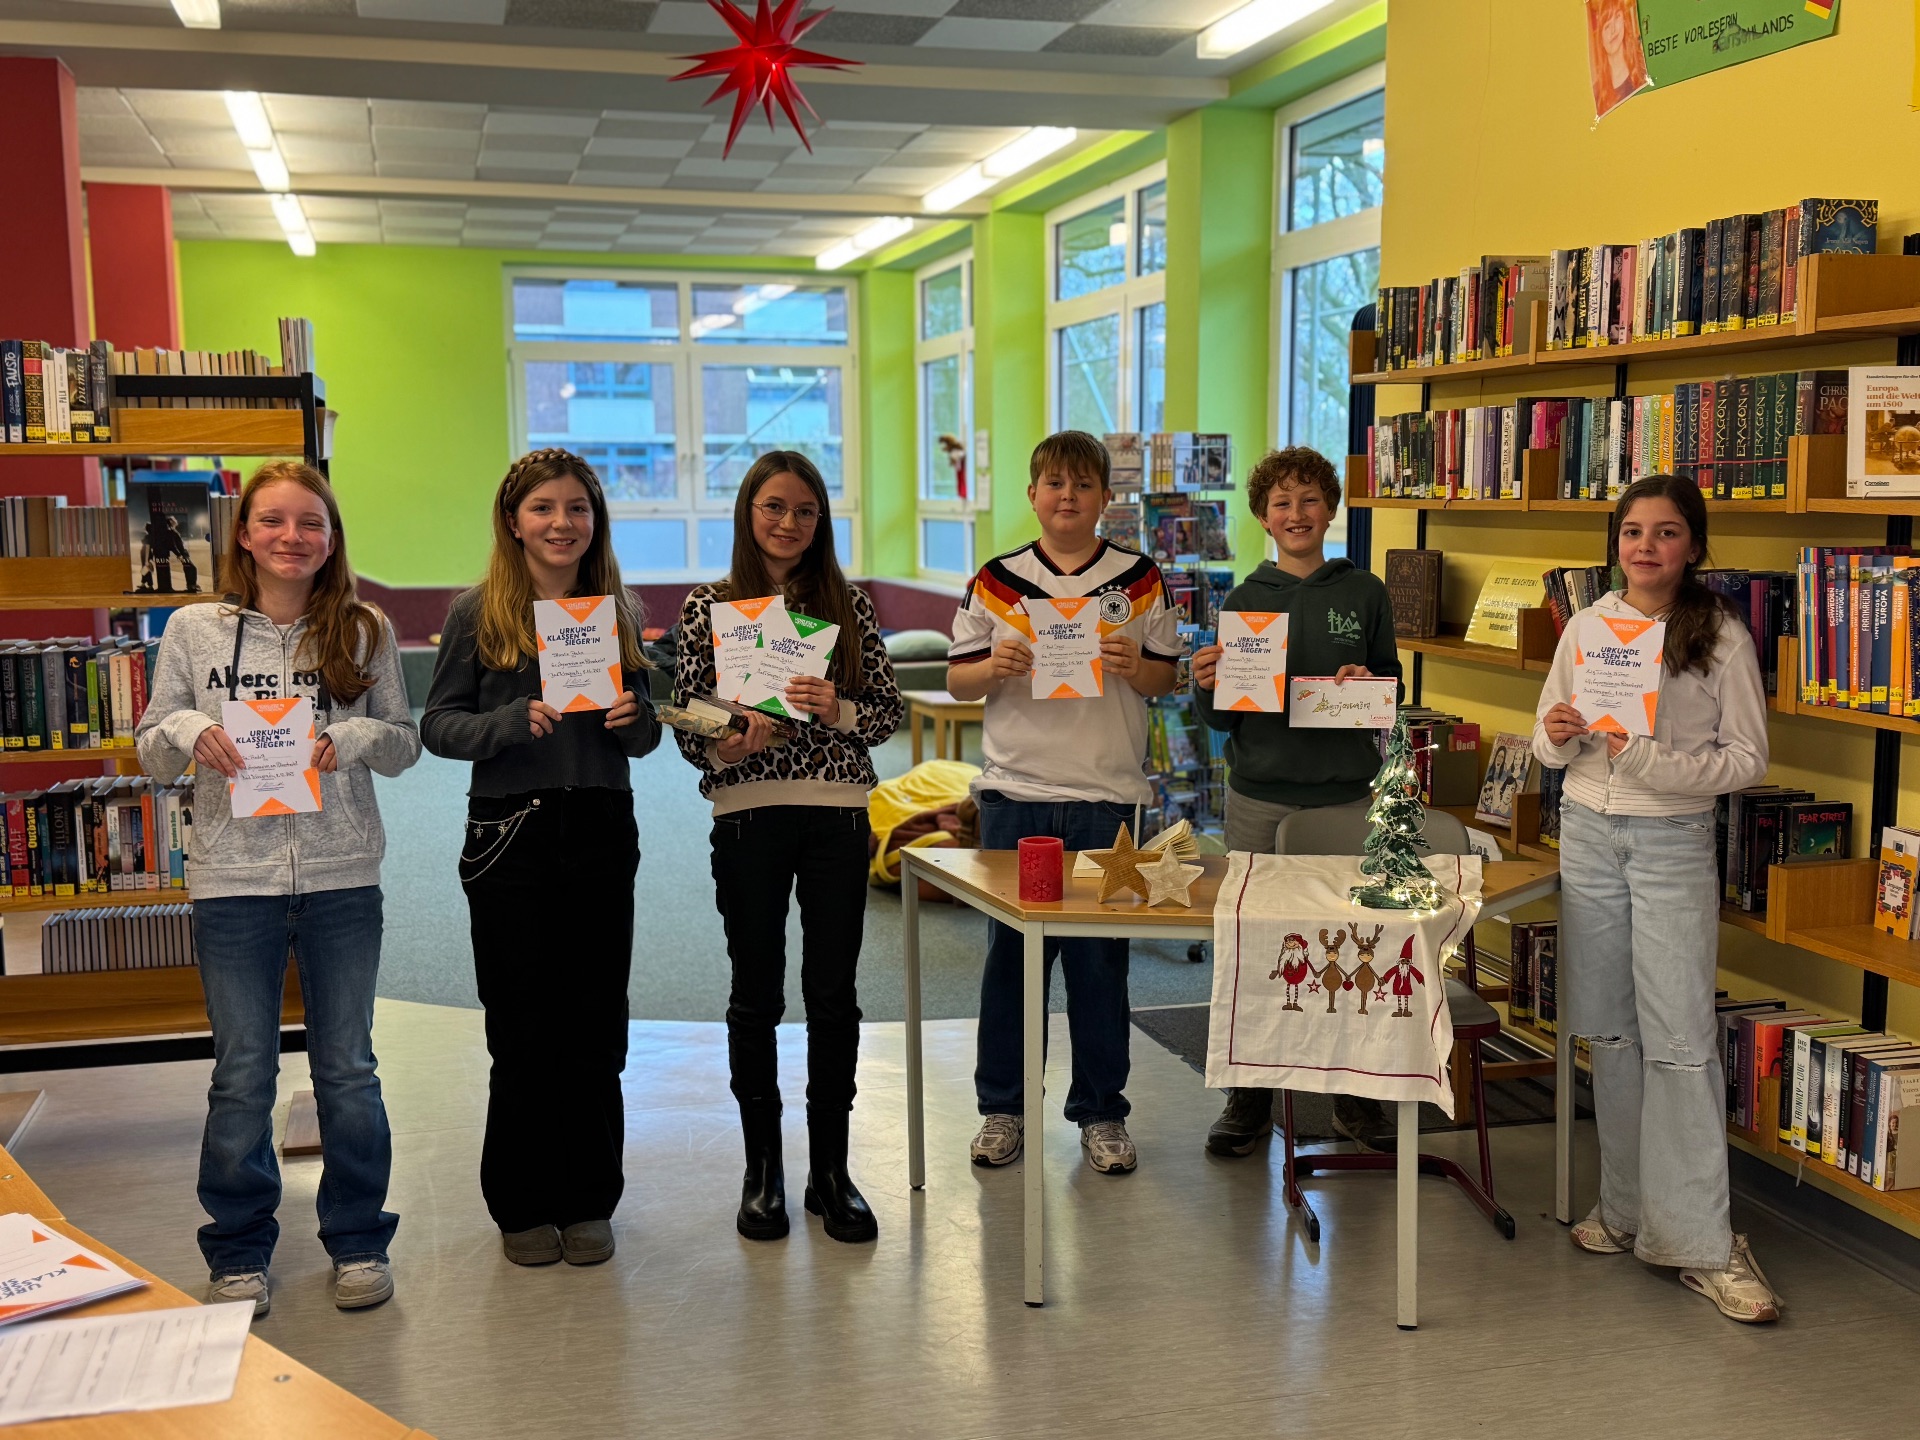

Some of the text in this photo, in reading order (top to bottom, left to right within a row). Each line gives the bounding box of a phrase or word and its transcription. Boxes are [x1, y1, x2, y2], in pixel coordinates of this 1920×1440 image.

[1648, 12, 1738, 57] BESTE VORLESERIN
[1590, 285, 1598, 315] WELT
[5, 352, 19, 388] FAUSTO
[1820, 385, 1848, 396] CHRIS
[1866, 384, 1899, 393] Europa
[1886, 392, 1899, 400] die
[1900, 392, 1920, 400] Welt
[1674, 404, 1683, 460] ERAGON
[1689, 403, 1698, 460] ERAGON
[1700, 401, 1710, 459] ERAGON
[1716, 398, 1727, 458] ERAGON
[1736, 397, 1748, 457] ERAGON
[1754, 396, 1766, 456] ERAGON
[1774, 393, 1785, 455] ERAGON
[1389, 588, 1422, 596] MAXTON
[1395, 595, 1415, 604] HALL
[1861, 589, 1870, 632] FRANKREICH
[1880, 589, 1888, 625] EUROPA
[547, 633, 580, 642] KLASSEN
[559, 626, 597, 634] URKUNDE
[721, 630, 752, 639] KLASSEN
[733, 623, 763, 632] URKUND
[1038, 628, 1067, 636] KLASSEN
[770, 639, 793, 650] SCHUL
[782, 636, 817, 651] URKUNDE
[1600, 647, 1640, 656] URKUNDE
[1586, 651, 1621, 660] KLASSEN
[2, 658, 11, 691] RECKLESS
[23, 659, 32, 691] RECKLESS
[47, 658, 56, 690] RECKLESS
[236, 735, 272, 744] KLASSEN
[250, 728, 291, 737] URKUNDE
[1456, 739, 1476, 751] ÜBER
[26, 807, 38, 849] Outback
[54, 805, 65, 850] FILLORY
[1798, 812, 1847, 824] FEAR STREET
[10, 828, 22, 861] HALF
